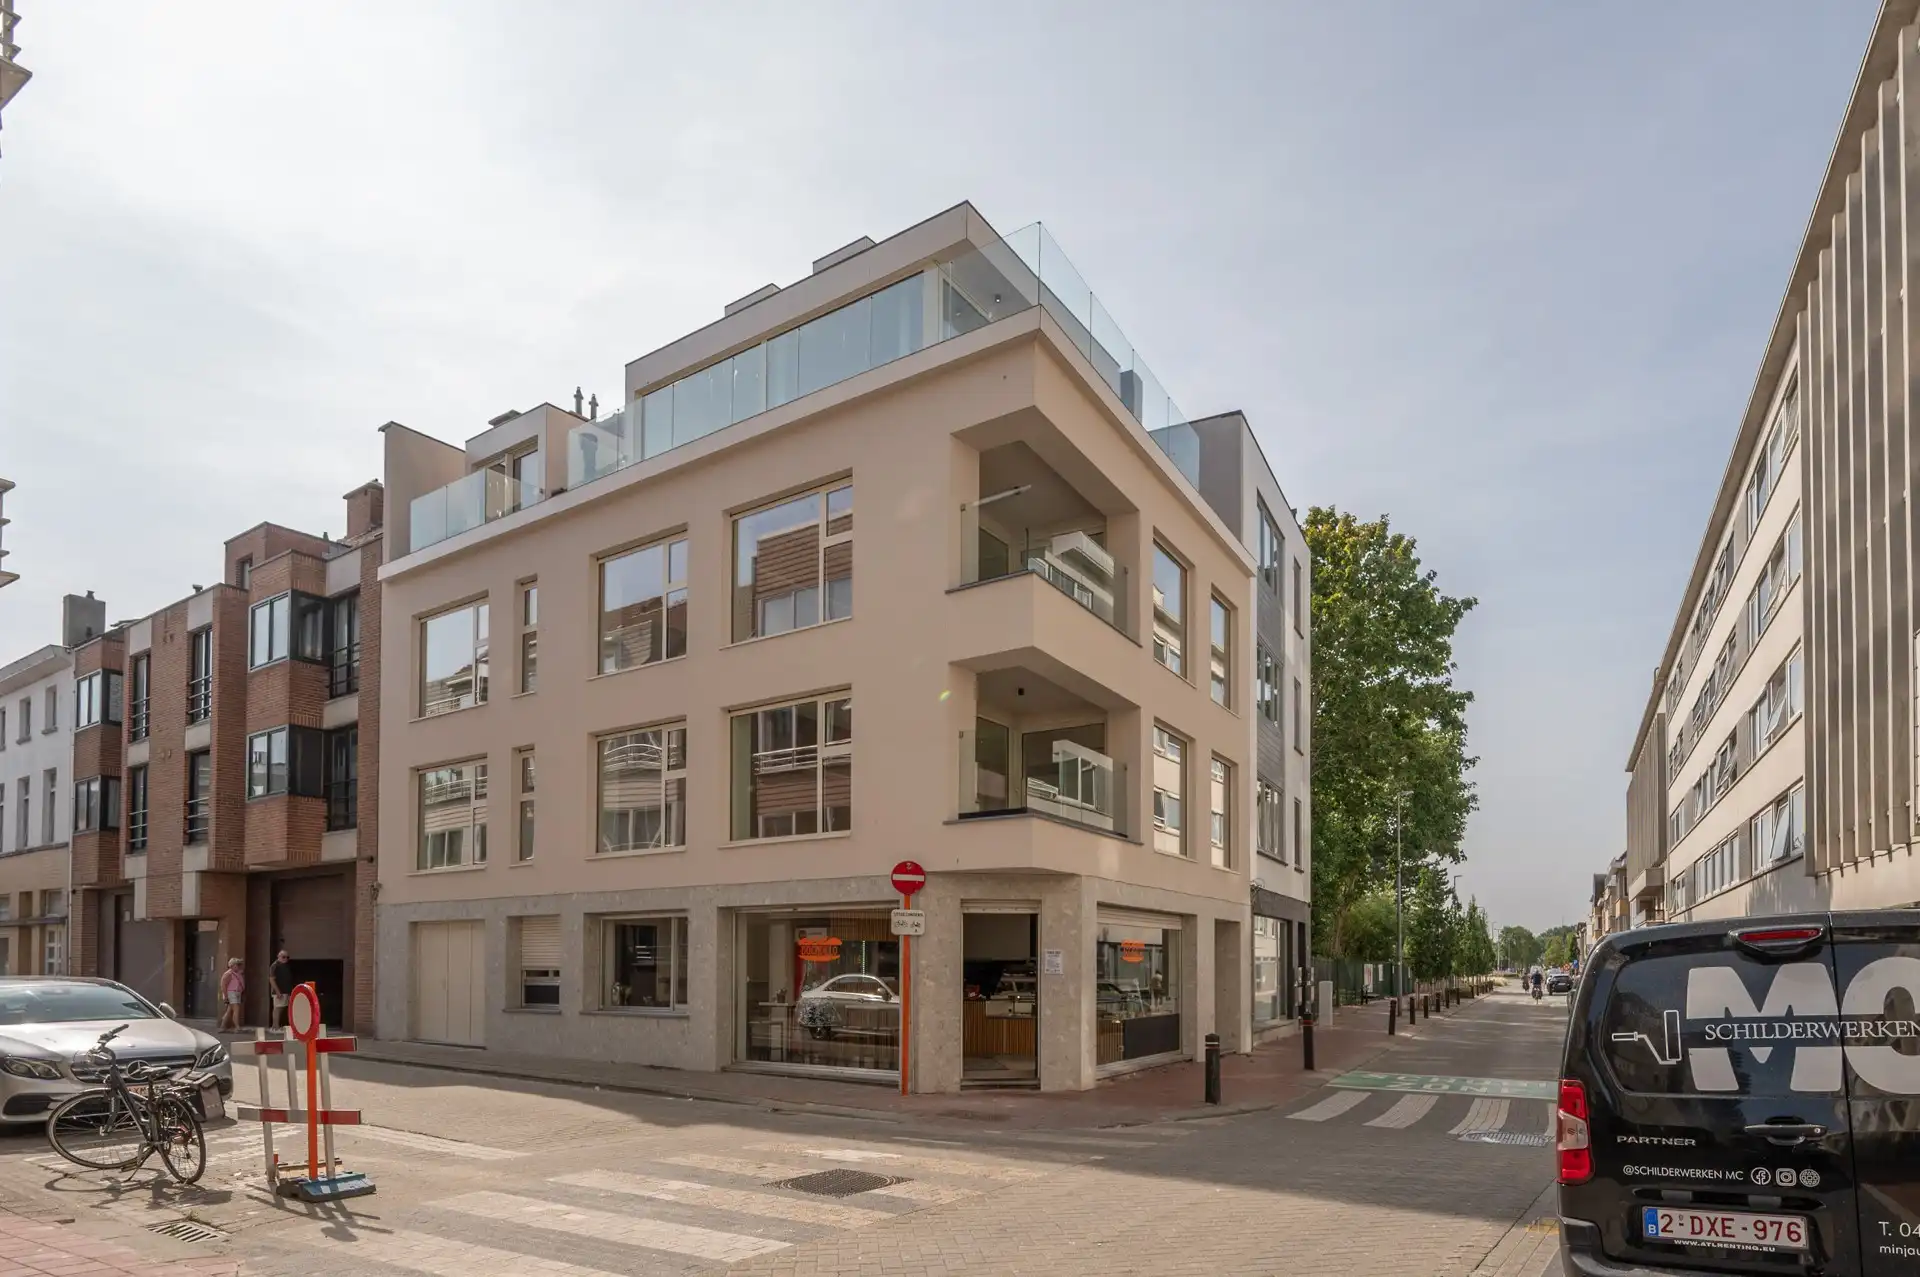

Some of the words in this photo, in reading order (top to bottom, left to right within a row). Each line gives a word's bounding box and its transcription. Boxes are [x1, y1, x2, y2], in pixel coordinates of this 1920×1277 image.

[1616, 1135, 1697, 1147] PARTNER
[1623, 1164, 1723, 1180] @SCHILDERWERKEN
[1726, 1170, 1744, 1181] MC
[1648, 1224, 1656, 1234] B
[1878, 1221, 1892, 1236] T.
[1899, 1222, 1920, 1238] 04
[1674, 1239, 1776, 1252] WWW.ATLRENTING.EU
